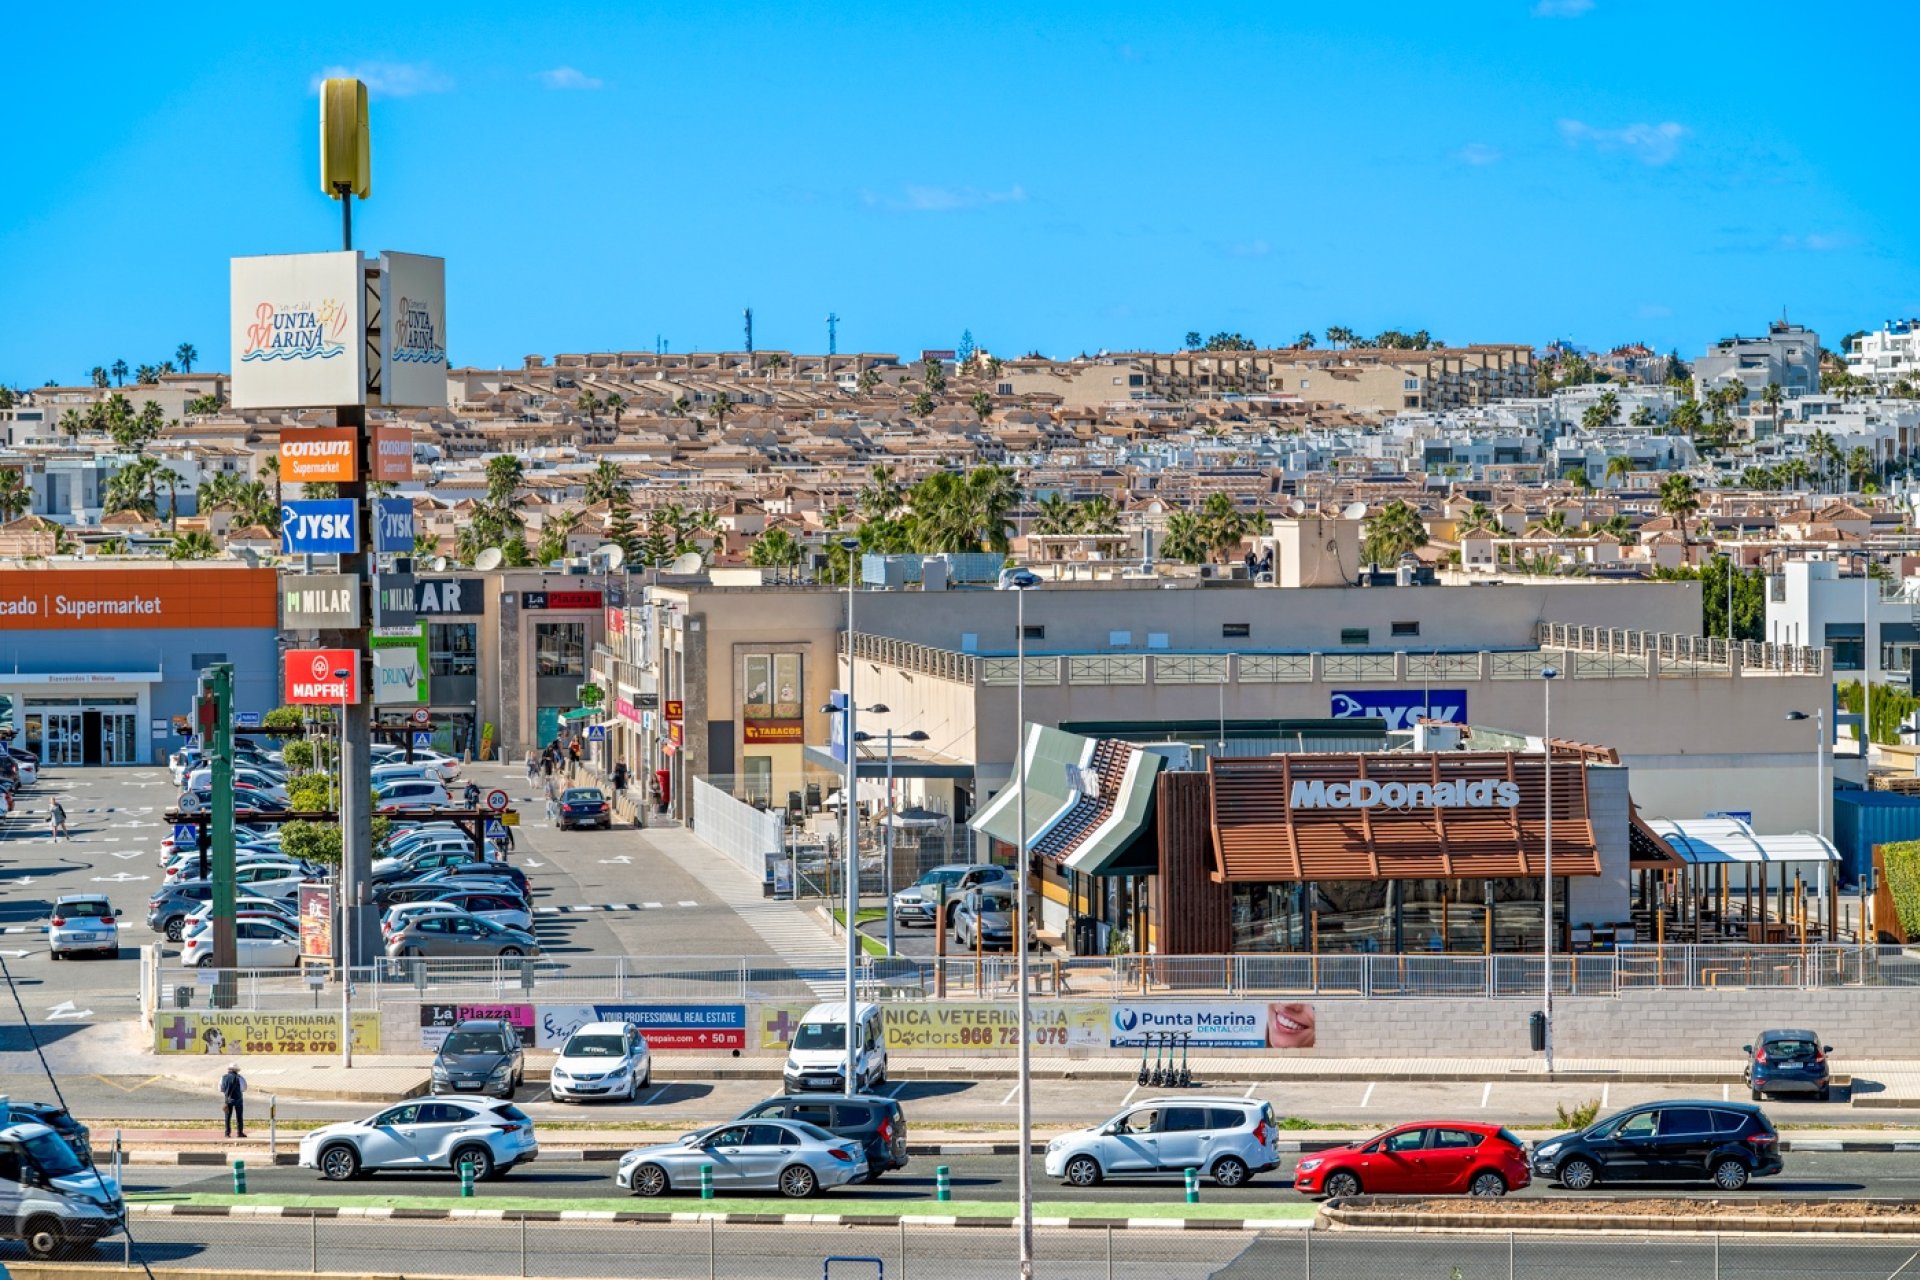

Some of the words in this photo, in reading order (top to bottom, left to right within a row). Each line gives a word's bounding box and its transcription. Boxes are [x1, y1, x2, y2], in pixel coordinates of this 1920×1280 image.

[256, 303, 316, 330] PUNTA
[245, 323, 323, 354] MARINA
[282, 440, 351, 457] consum
[293, 460, 340, 477] Supermarket
[296, 514, 351, 539] JYSK
[386, 513, 413, 538] JYSK
[302, 589, 350, 613] MILAR
[389, 588, 414, 611] MILAR
[416, 582, 462, 611] AR
[528, 593, 544, 604] La
[551, 593, 591, 603] Plazza
[55, 595, 162, 619] Supermarket
[293, 683, 348, 698] MAPFRE
[759, 727, 801, 735] TABACOS
[491, 796, 504, 805] 20
[1290, 778, 1520, 808] McDonald's
[201, 1013, 250, 1025] CLÍNICA
[254, 1015, 336, 1025] VETERINARIA
[433, 1007, 453, 1019] La
[460, 1007, 512, 1019] Plazza
[601, 1012, 623, 1023] YOUR
[624, 1012, 682, 1023] PROFESSIONAL
[684, 1012, 704, 1023] REAL
[706, 1012, 736, 1023] ESTATE
[1142, 1012, 1193, 1026] Punta
[1197, 1011, 1256, 1026] Marina
[246, 1025, 269, 1040] Pet
[644, 1033, 694, 1044] lespain.com
[711, 1033, 724, 1043] 50
[727, 1035, 737, 1043] m
[960, 1027, 993, 1044] 966
[998, 1027, 1031, 1044] 72
[1036, 1027, 1069, 1044] 079
[246, 1041, 273, 1052] 966
[278, 1041, 305, 1052] 722
[309, 1041, 336, 1052] 079
